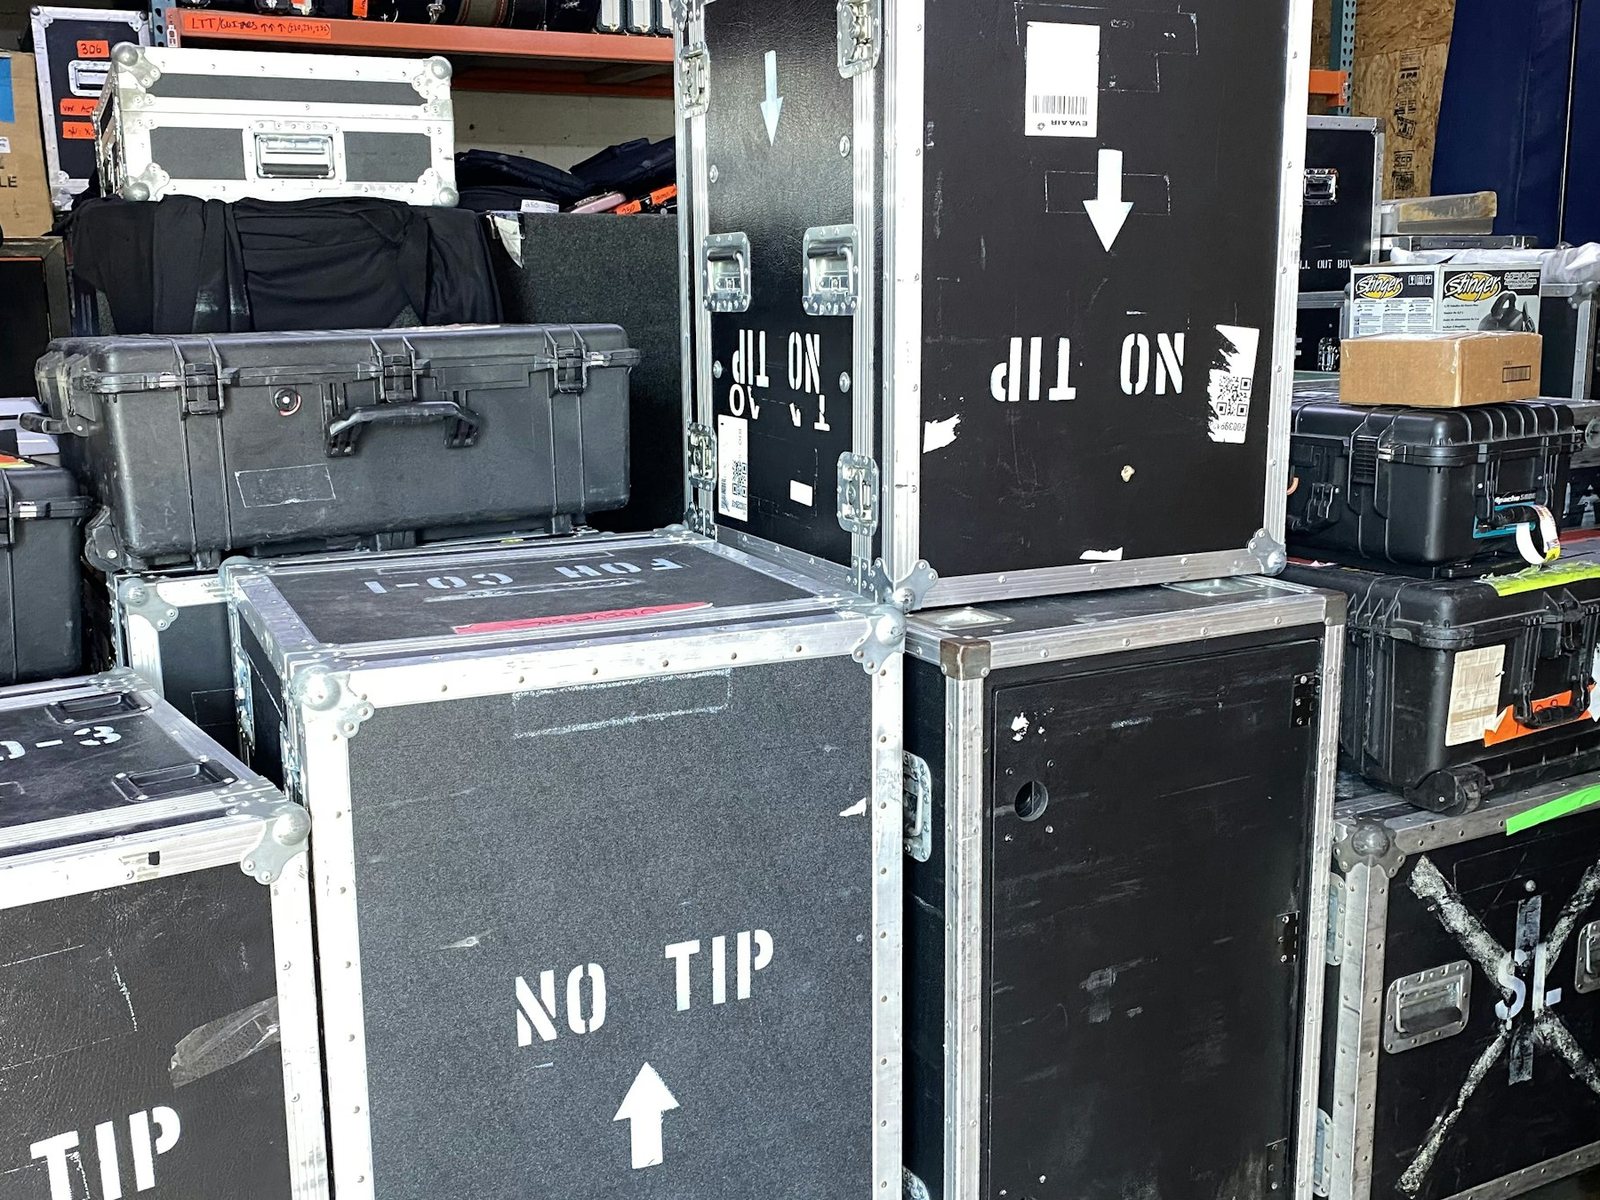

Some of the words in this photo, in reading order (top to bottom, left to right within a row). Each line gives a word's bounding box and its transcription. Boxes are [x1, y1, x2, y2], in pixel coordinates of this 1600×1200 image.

[80, 43, 102, 55] 306
[1068, 119, 1088, 127] EVA
[1317, 259, 1333, 269] OUT
[1356, 274, 1403, 300] Stinger
[1444, 272, 1501, 303] Stinger
[731, 329, 770, 388] TIP
[788, 331, 820, 394] NO
[990, 336, 1077, 402] TIP
[1120, 332, 1185, 396] NO
[554, 557, 684, 579] FOH
[515, 962, 607, 1047] NO
[665, 929, 774, 1012] TIP
[30, 1105, 181, 1200] TIP
